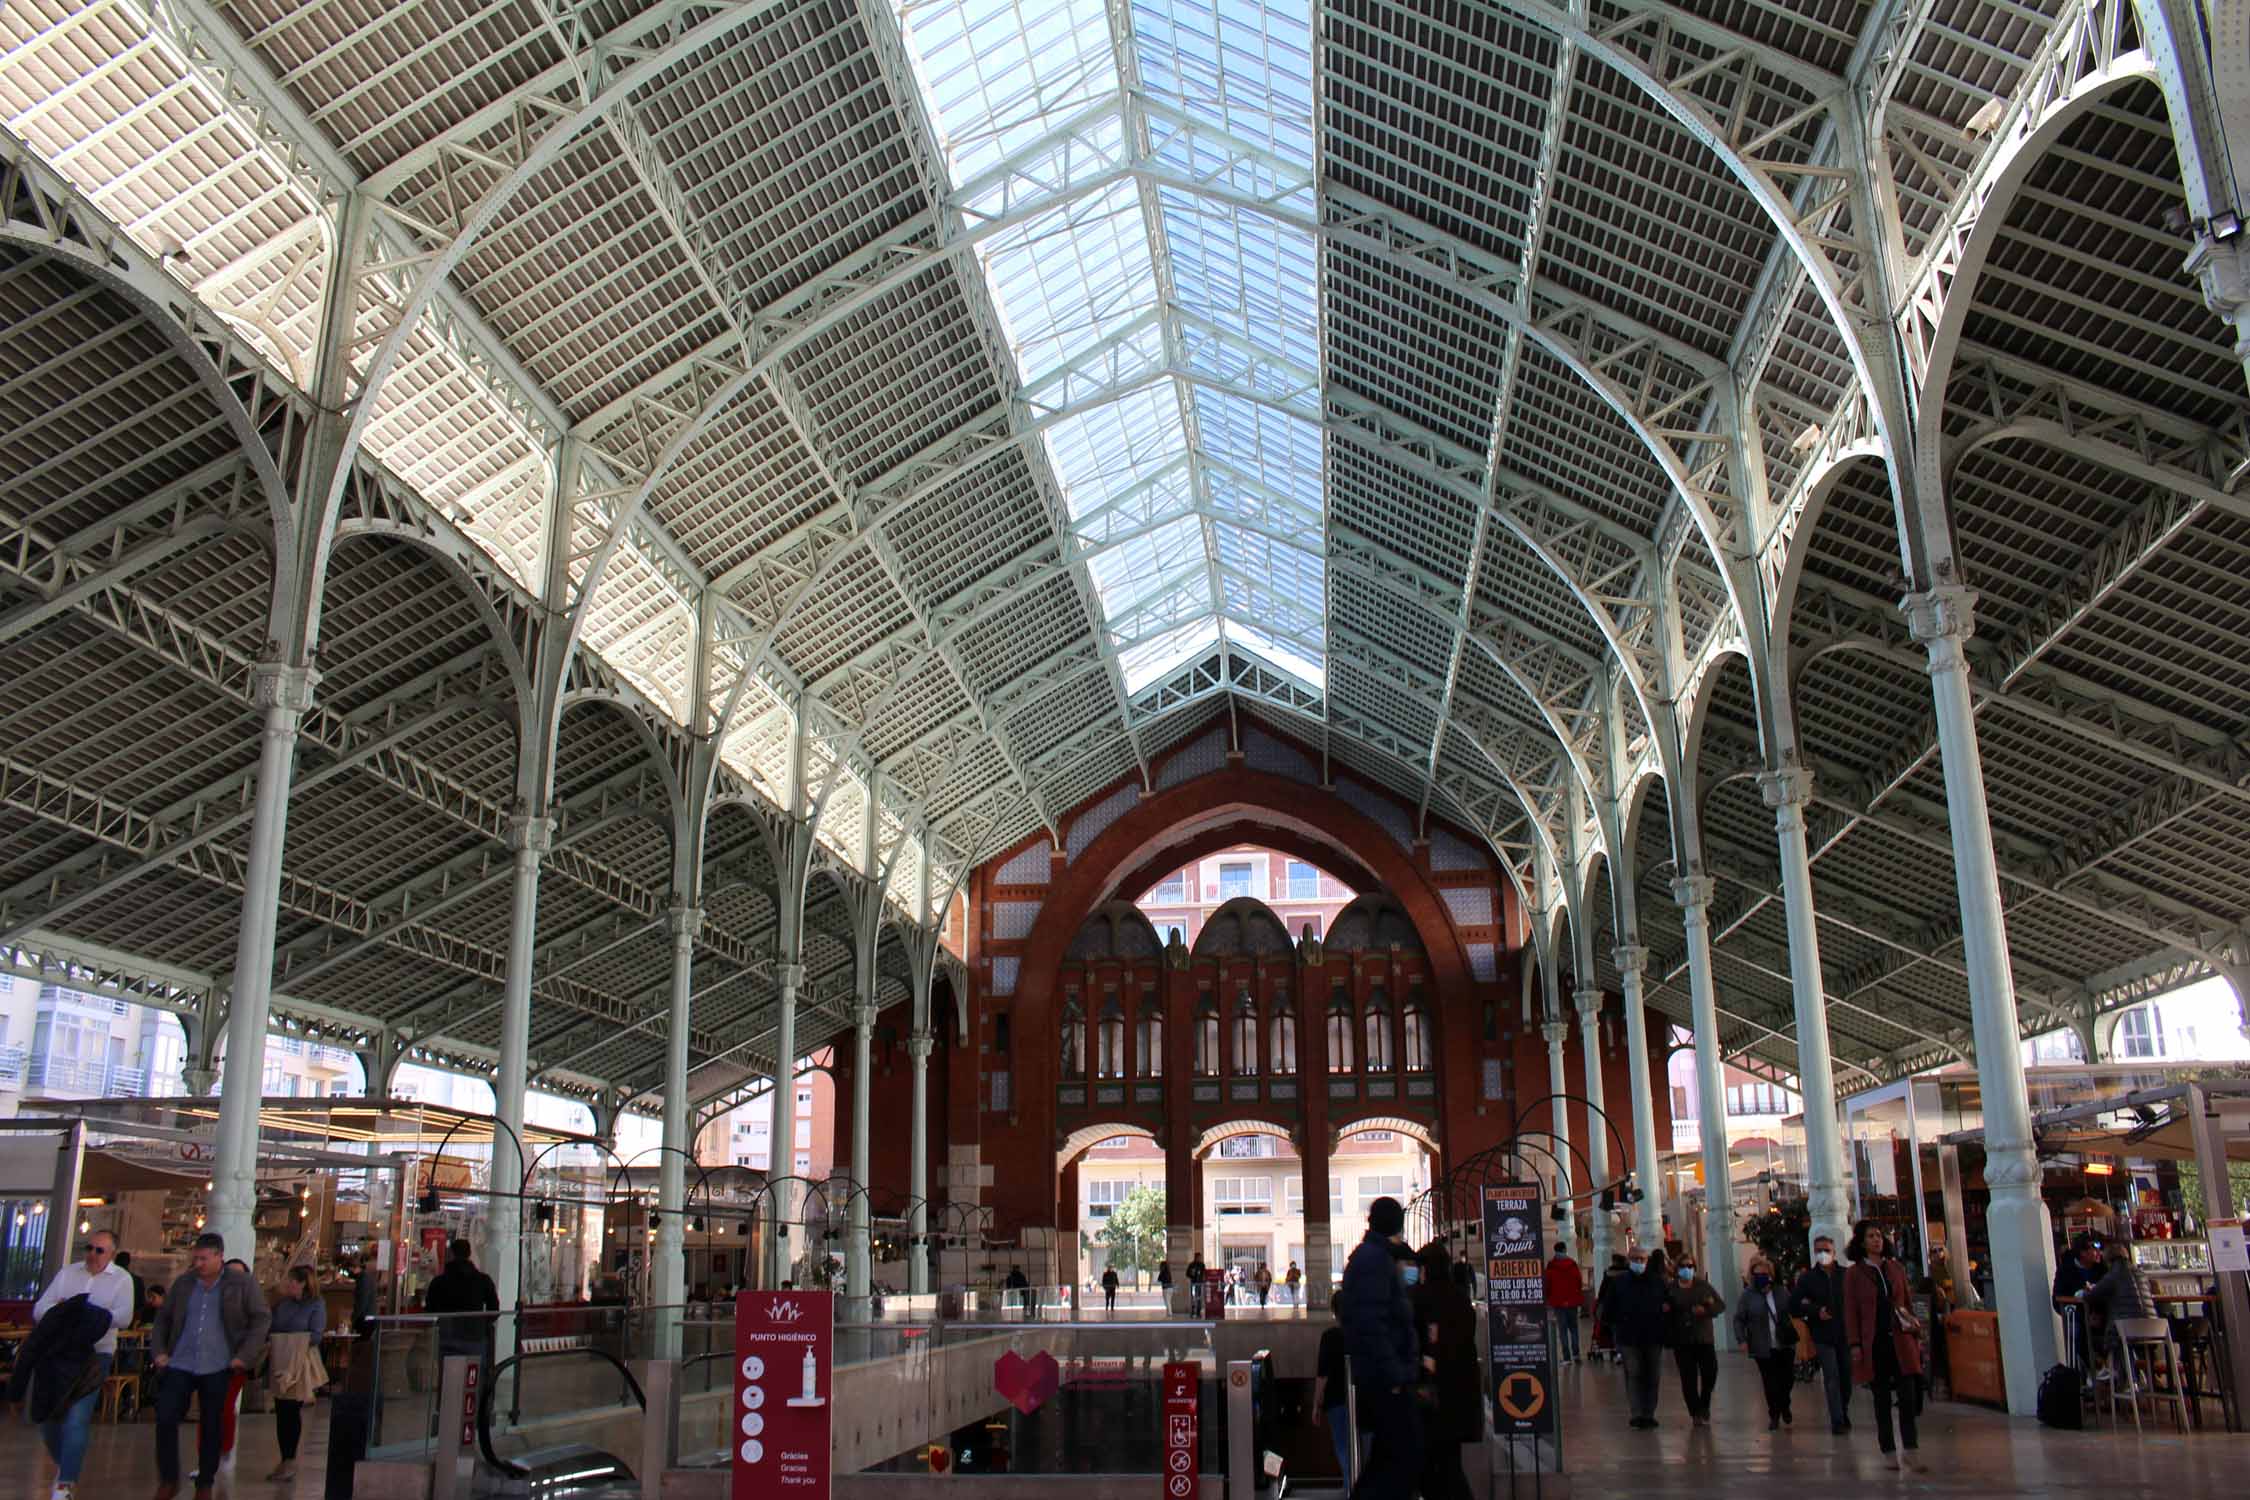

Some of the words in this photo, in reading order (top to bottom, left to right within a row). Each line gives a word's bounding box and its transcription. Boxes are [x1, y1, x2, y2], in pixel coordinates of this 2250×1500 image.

[1496, 1199, 1528, 1211] TERRAZA
[1493, 1240, 1534, 1257] Down
[1494, 1260, 1539, 1277] ABIERTO
[1490, 1279, 1511, 1290] TODOS
[1512, 1279, 1525, 1289] LOS
[1490, 1290, 1499, 1300] DE
[1521, 1289, 1527, 1299] A
[1528, 1288, 1542, 1299] 2:00
[751, 1333, 776, 1341] PUNTO
[781, 1475, 801, 1484] Thank
[802, 1477, 816, 1486] you
